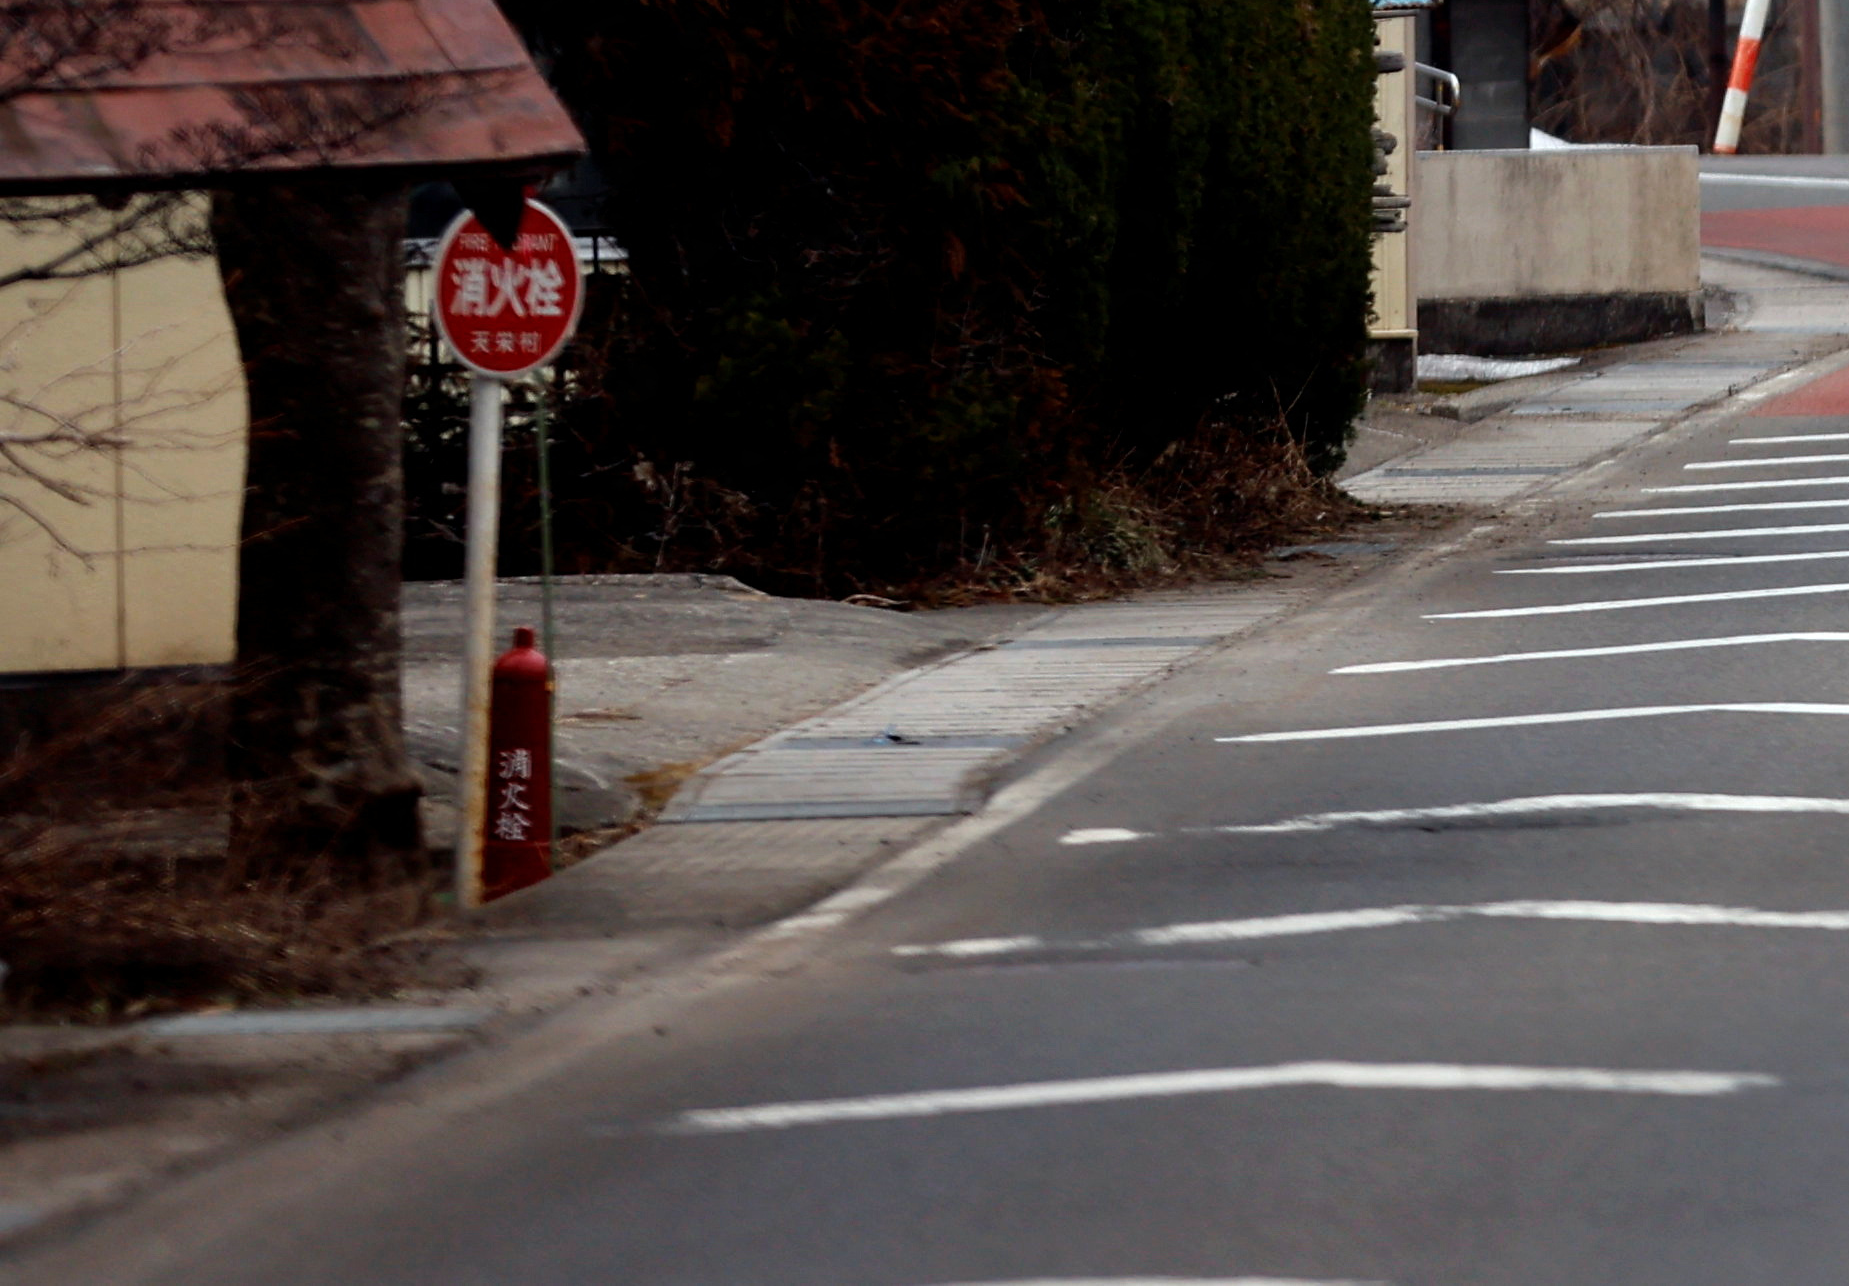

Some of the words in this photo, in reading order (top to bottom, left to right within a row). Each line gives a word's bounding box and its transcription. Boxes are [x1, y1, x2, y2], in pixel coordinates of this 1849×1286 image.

[449, 256, 566, 317] 消火栓
[471, 331, 541, 354] 天栄村
[495, 748, 533, 841] 消火栓
